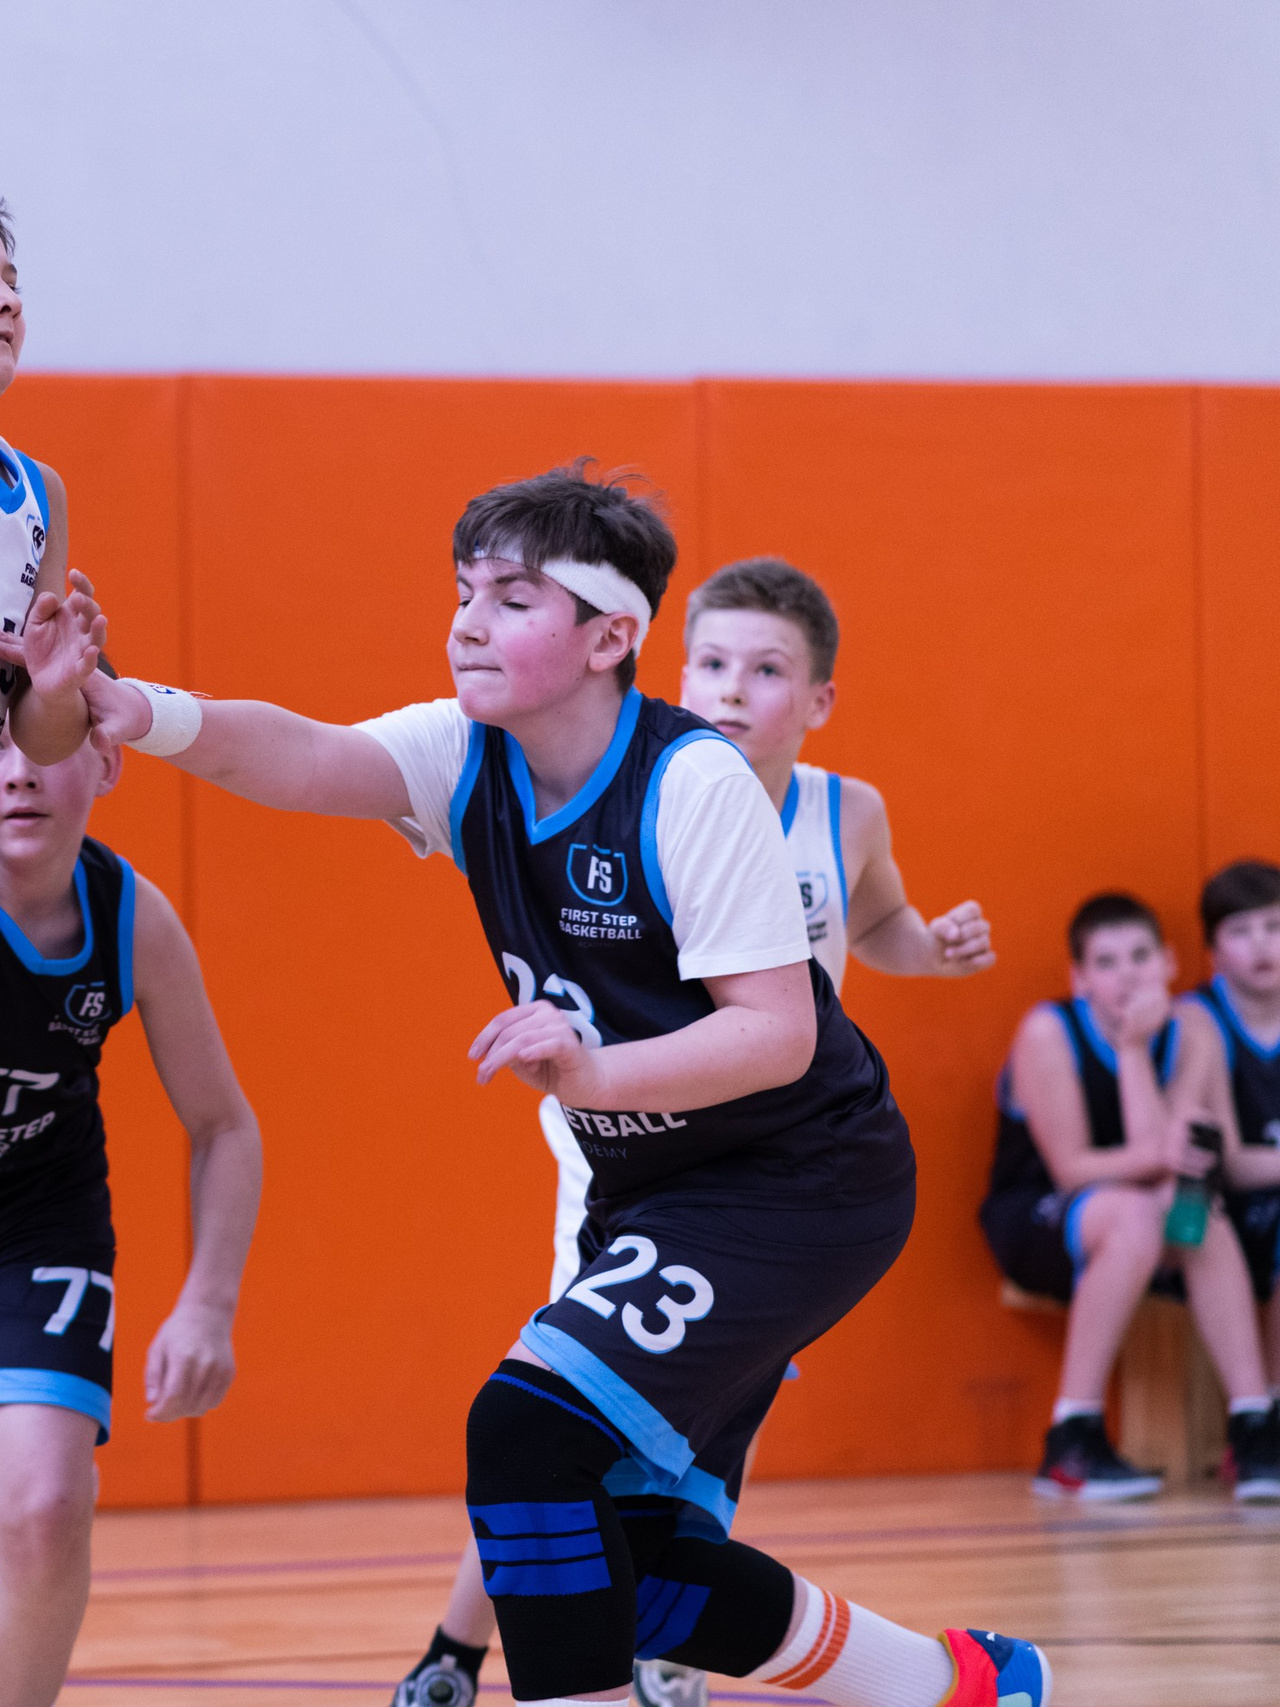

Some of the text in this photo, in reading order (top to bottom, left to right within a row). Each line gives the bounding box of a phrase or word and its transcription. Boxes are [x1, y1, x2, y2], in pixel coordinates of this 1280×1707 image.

[587, 855, 612, 894] FS
[799, 882, 813, 908] S
[561, 907, 637, 927] FIRST STEP
[559, 920, 643, 940] BASKETBALL
[79, 992, 105, 1017] FS
[562, 1105, 688, 1137] ETBALL
[581, 1141, 627, 1159] DEMY
[565, 1235, 714, 1354] 23
